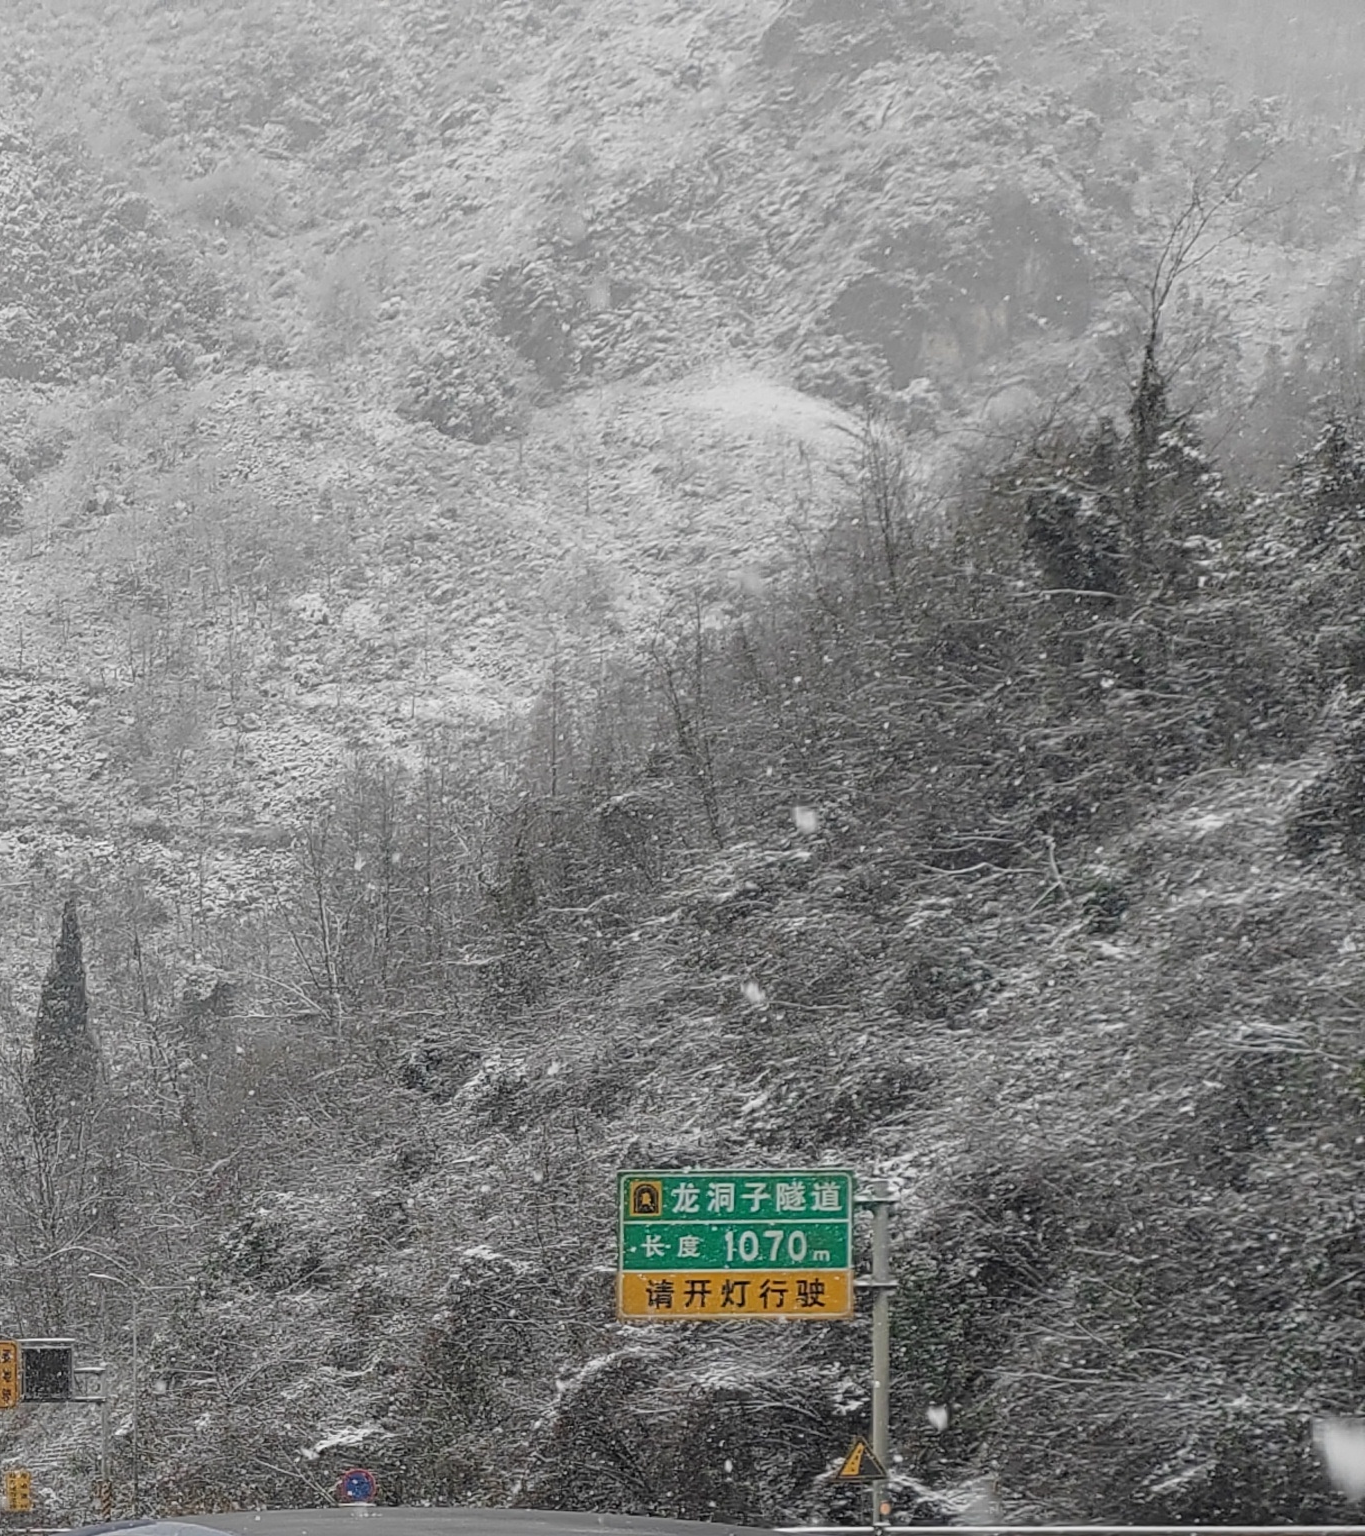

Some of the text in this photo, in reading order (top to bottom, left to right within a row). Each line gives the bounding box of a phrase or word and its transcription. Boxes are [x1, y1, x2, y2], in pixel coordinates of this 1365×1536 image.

[671, 1181, 843, 1214] 龙洞子隧道
[640, 1235, 702, 1258] 长度
[645, 1278, 827, 1309] 请开灯行驶
